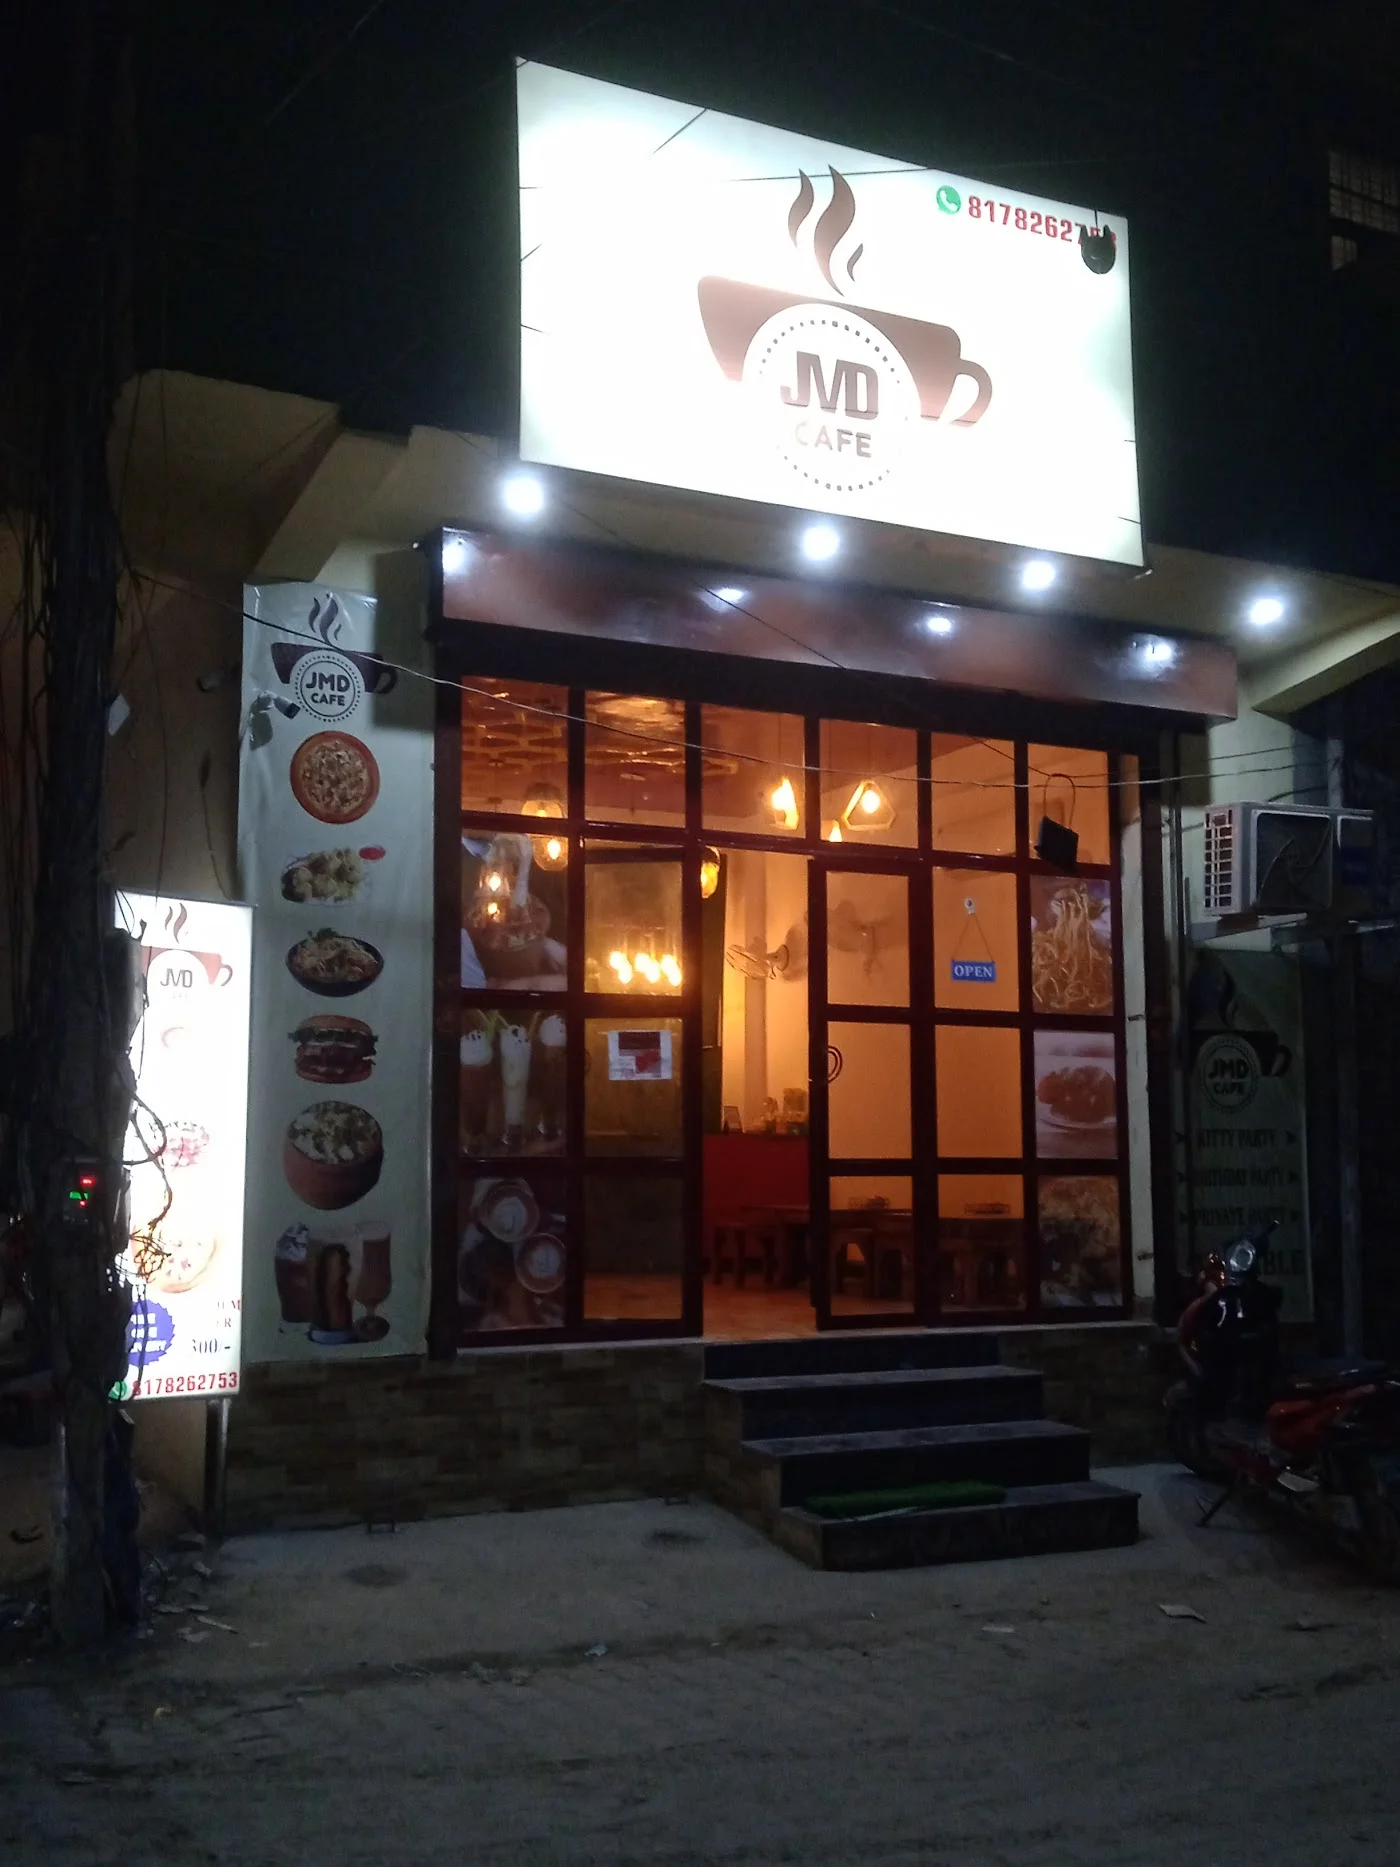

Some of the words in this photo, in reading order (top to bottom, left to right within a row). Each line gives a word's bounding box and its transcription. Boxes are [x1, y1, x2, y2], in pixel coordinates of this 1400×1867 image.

[968, 195, 1117, 251] 81782627
[780, 350, 879, 420] JMD
[794, 420, 872, 458] CAFE
[306, 672, 350, 692] JMD
[311, 693, 345, 706] CAFE
[159, 967, 193, 988] JMD
[954, 965, 992, 977] OPEN
[1208, 1058, 1250, 1079] JMD
[1213, 1081, 1245, 1095] CAFE
[132, 1371, 239, 1396] 8178262753
